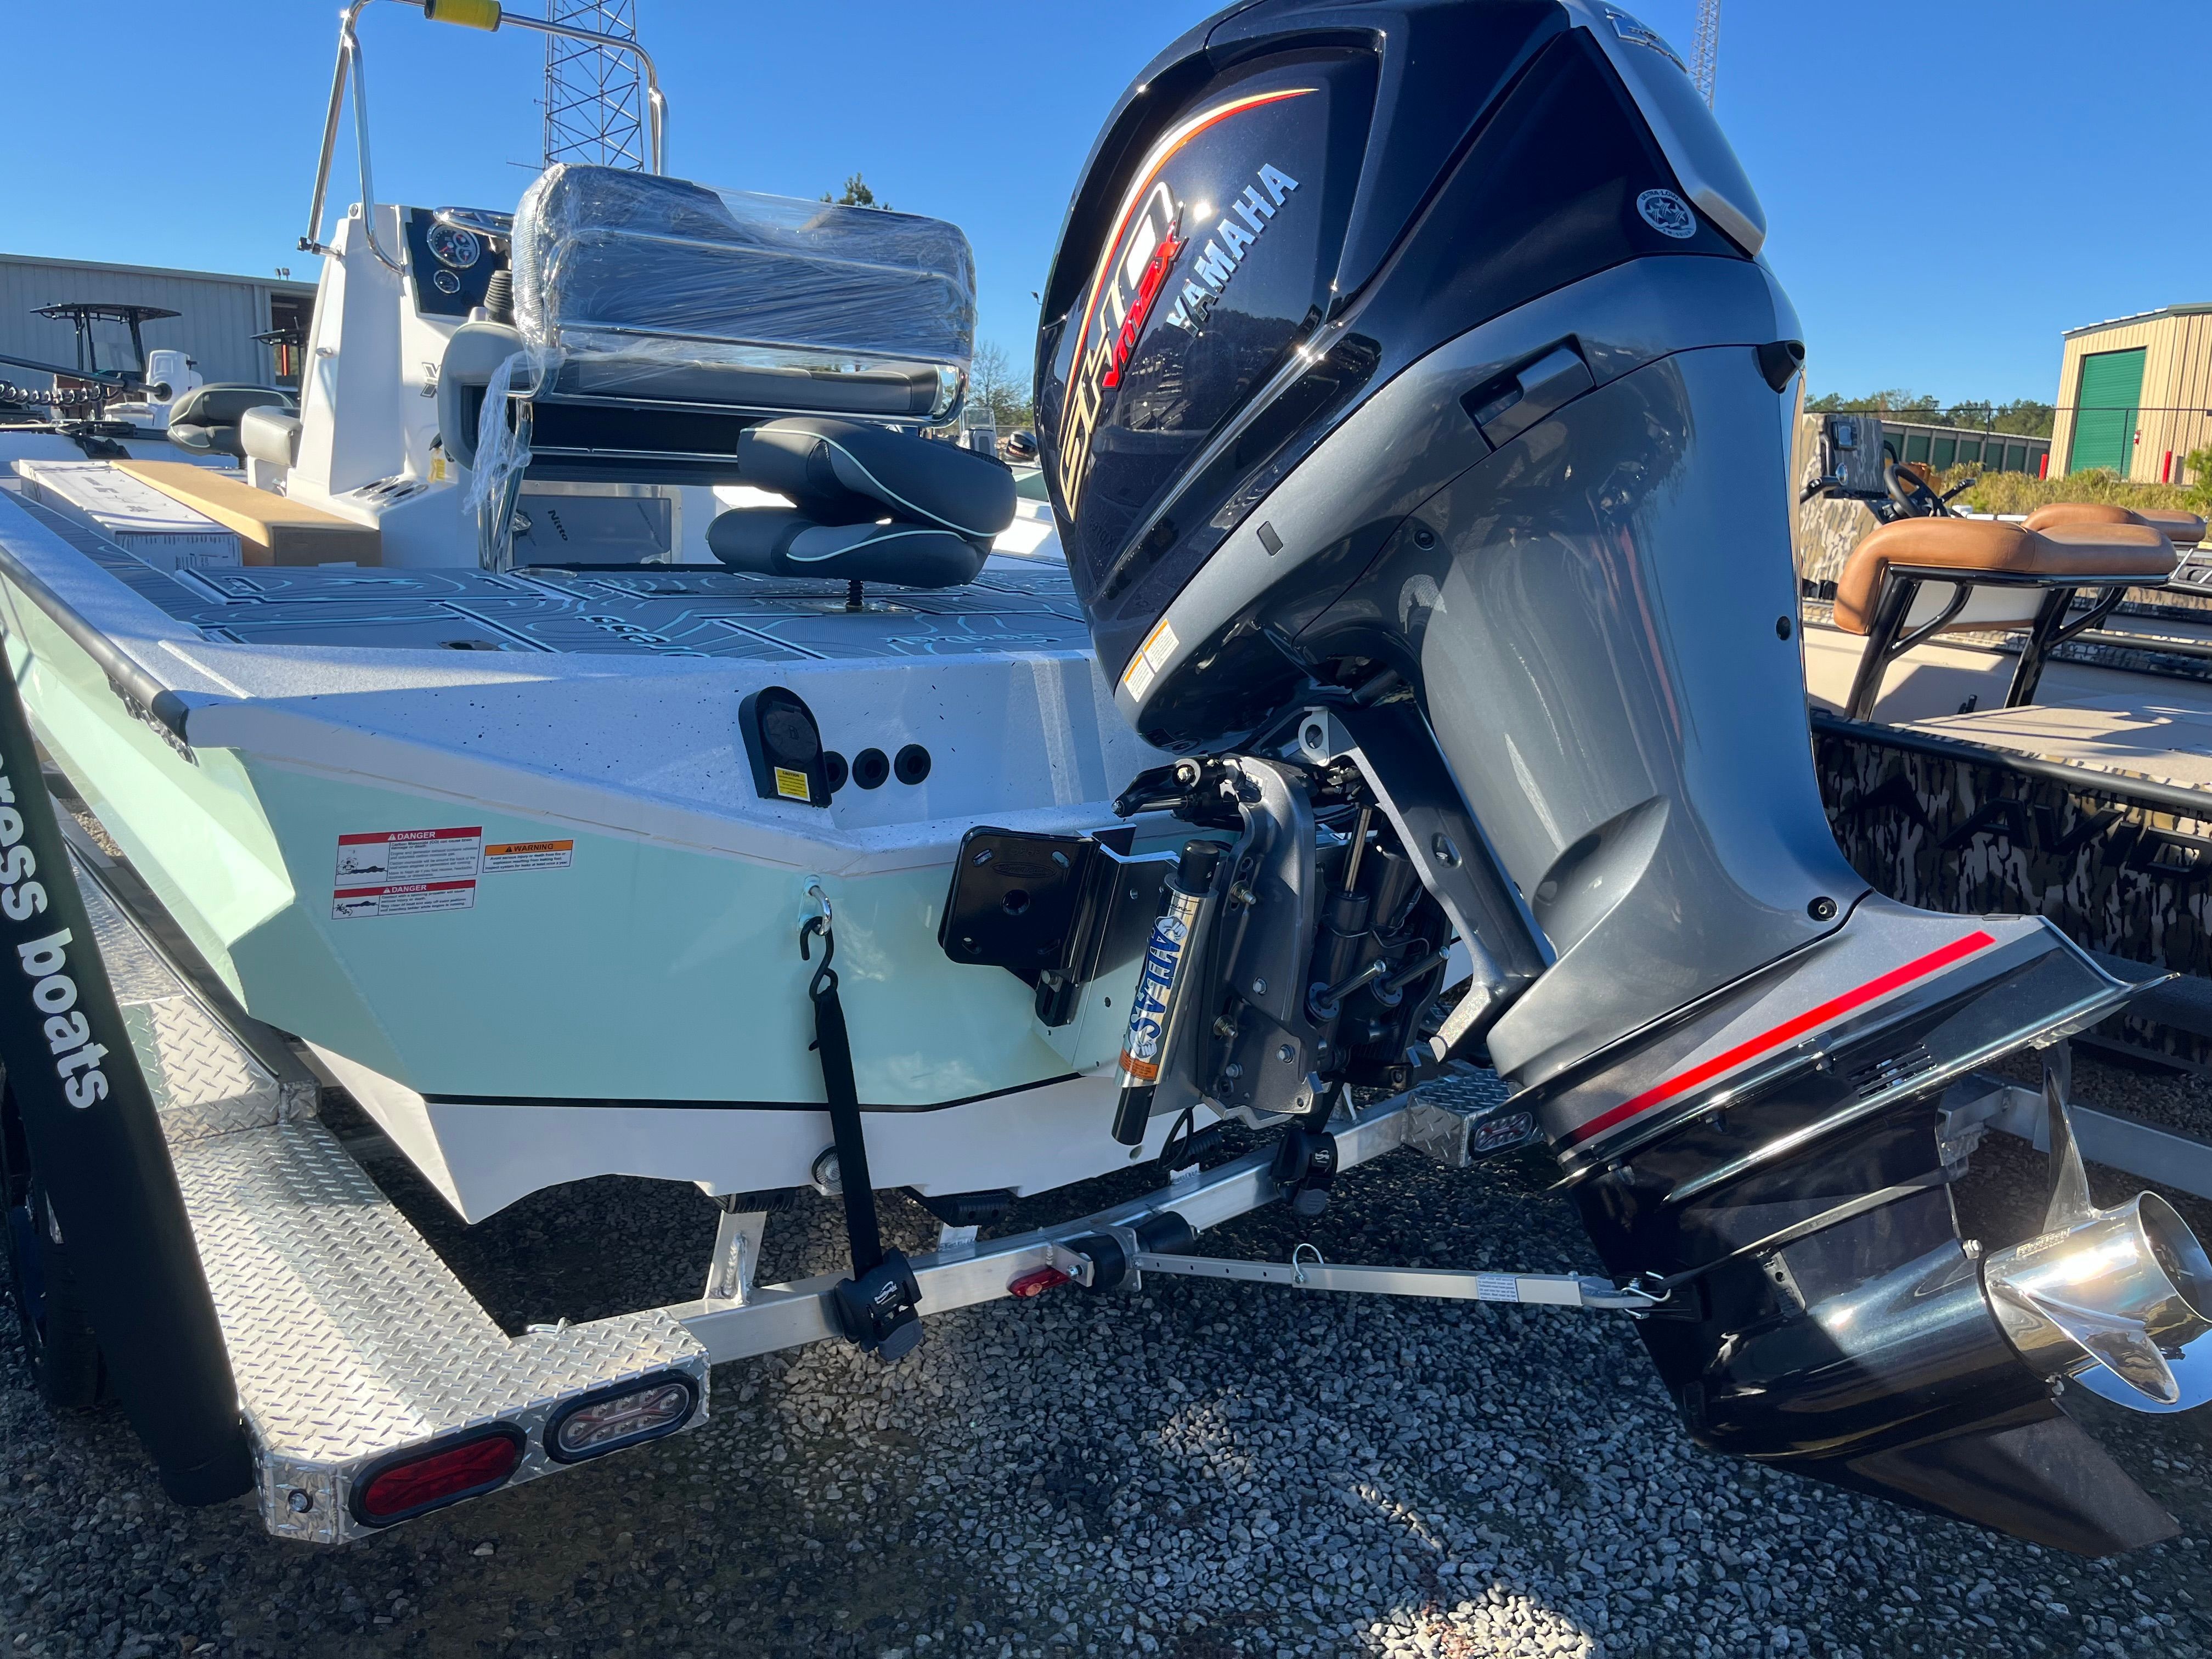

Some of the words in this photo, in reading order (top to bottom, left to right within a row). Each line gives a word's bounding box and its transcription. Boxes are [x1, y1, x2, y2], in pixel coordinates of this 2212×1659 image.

[1641, 190, 1659, 200] ULTRA
[1166, 163, 1299, 338] YAMAHA
[548, 510, 568, 541] Nitto
[397, 831, 436, 840] DANGER
[514, 843, 553, 852] WARNING
[392, 884, 427, 893] DANGER
[1129, 924, 1181, 1039] ATLAS
[17, 927, 109, 1109] boats
